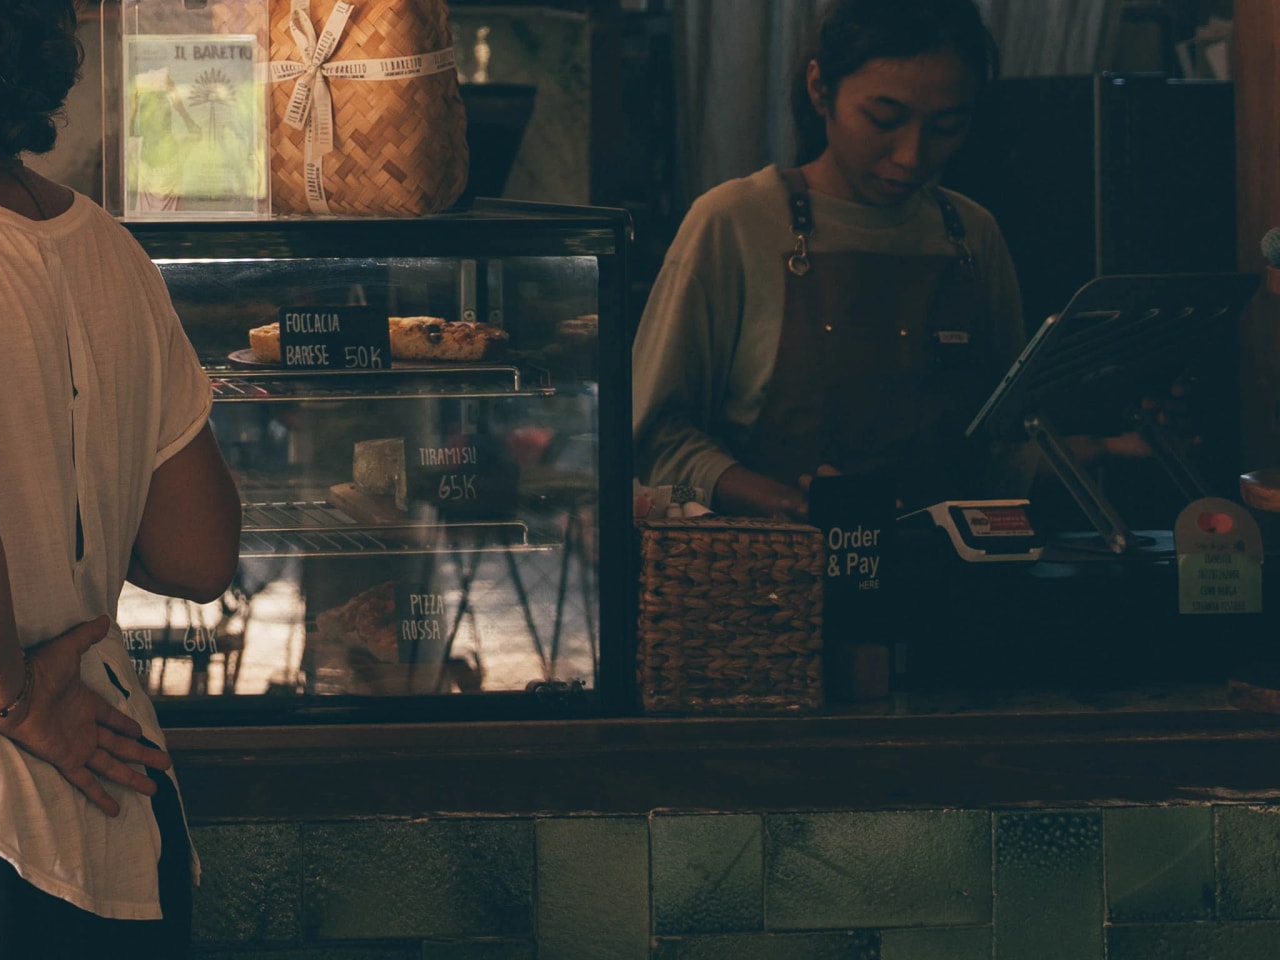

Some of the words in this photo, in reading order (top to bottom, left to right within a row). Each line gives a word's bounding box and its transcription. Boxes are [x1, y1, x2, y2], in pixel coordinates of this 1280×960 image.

[174, 45, 188, 61] IL
[193, 44, 253, 62] BARETTO
[285, 312, 341, 334] FOCCACIA
[286, 344, 330, 366] BARESE
[344, 346, 382, 369] 50K
[419, 447, 477, 466] TIRAMISU
[438, 474, 478, 501] 65K
[828, 524, 881, 551] Order
[827, 554, 841, 578] &
[847, 552, 881, 579] Pay
[858, 579, 881, 591] HERE
[409, 593, 444, 616] PIZZA
[122, 629, 152, 651] RESH
[402, 619, 441, 641] ROSSA
